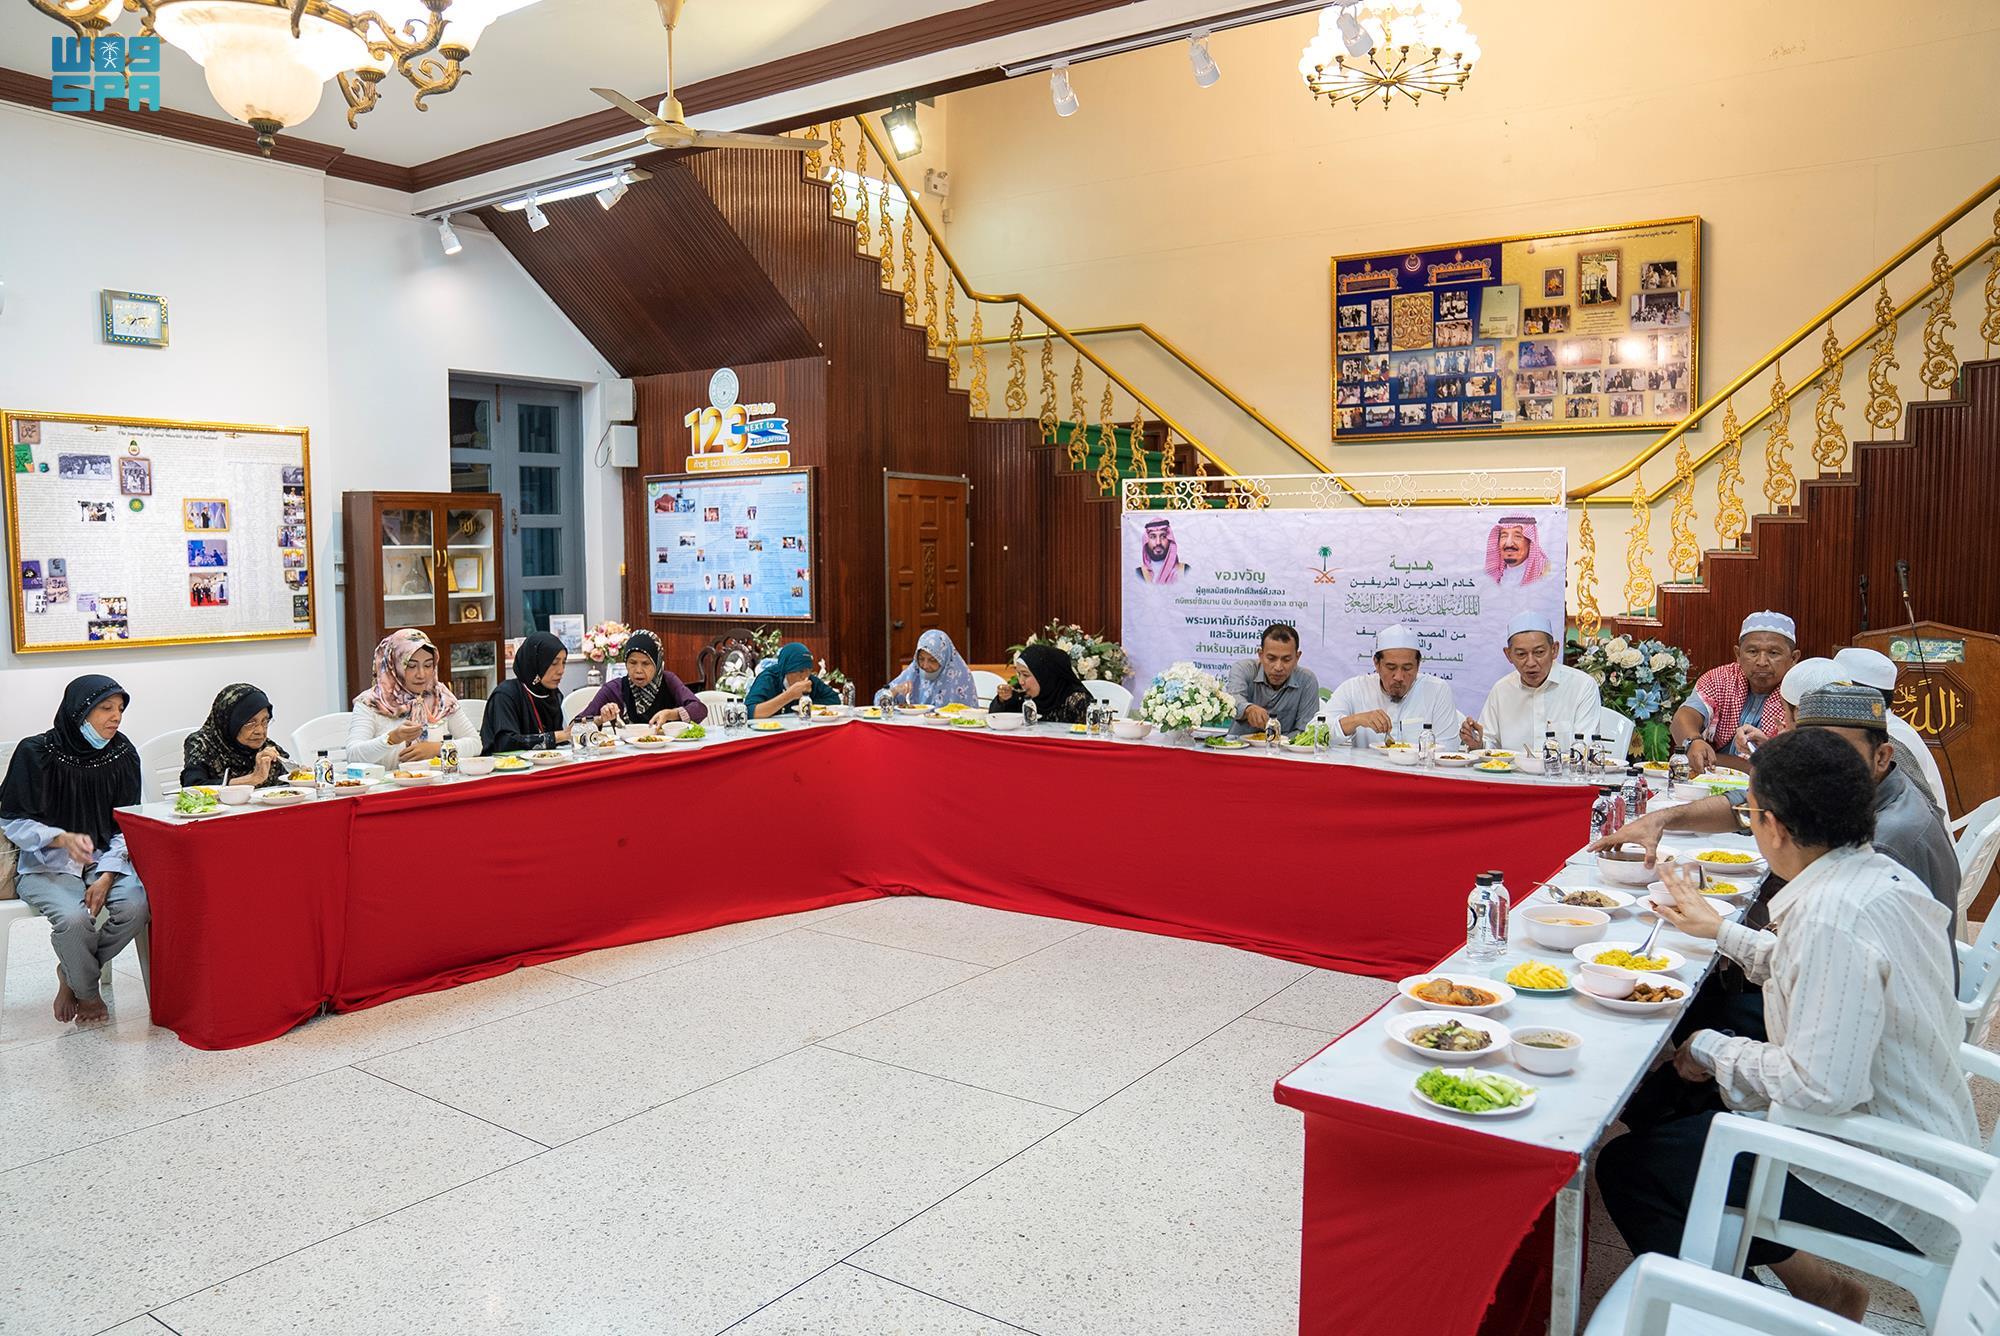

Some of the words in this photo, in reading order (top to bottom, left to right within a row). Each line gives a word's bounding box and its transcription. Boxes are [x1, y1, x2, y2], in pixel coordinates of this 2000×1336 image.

[746, 403, 776, 414] YEARS
[685, 404, 748, 454] 123
[744, 422, 763, 432] NEXT
[1389, 555, 1434, 574] هدية
[1215, 568, 1266, 583] ของขวัญ
[1350, 576, 1400, 588] الشريفين
[1403, 577, 1449, 589] الحرمين
[1452, 578, 1475, 589] خادم
[1209, 629, 1263, 640] และอินทผลั
[1450, 631, 1467, 640] من
[1420, 652, 1464, 663] للمسلمي
